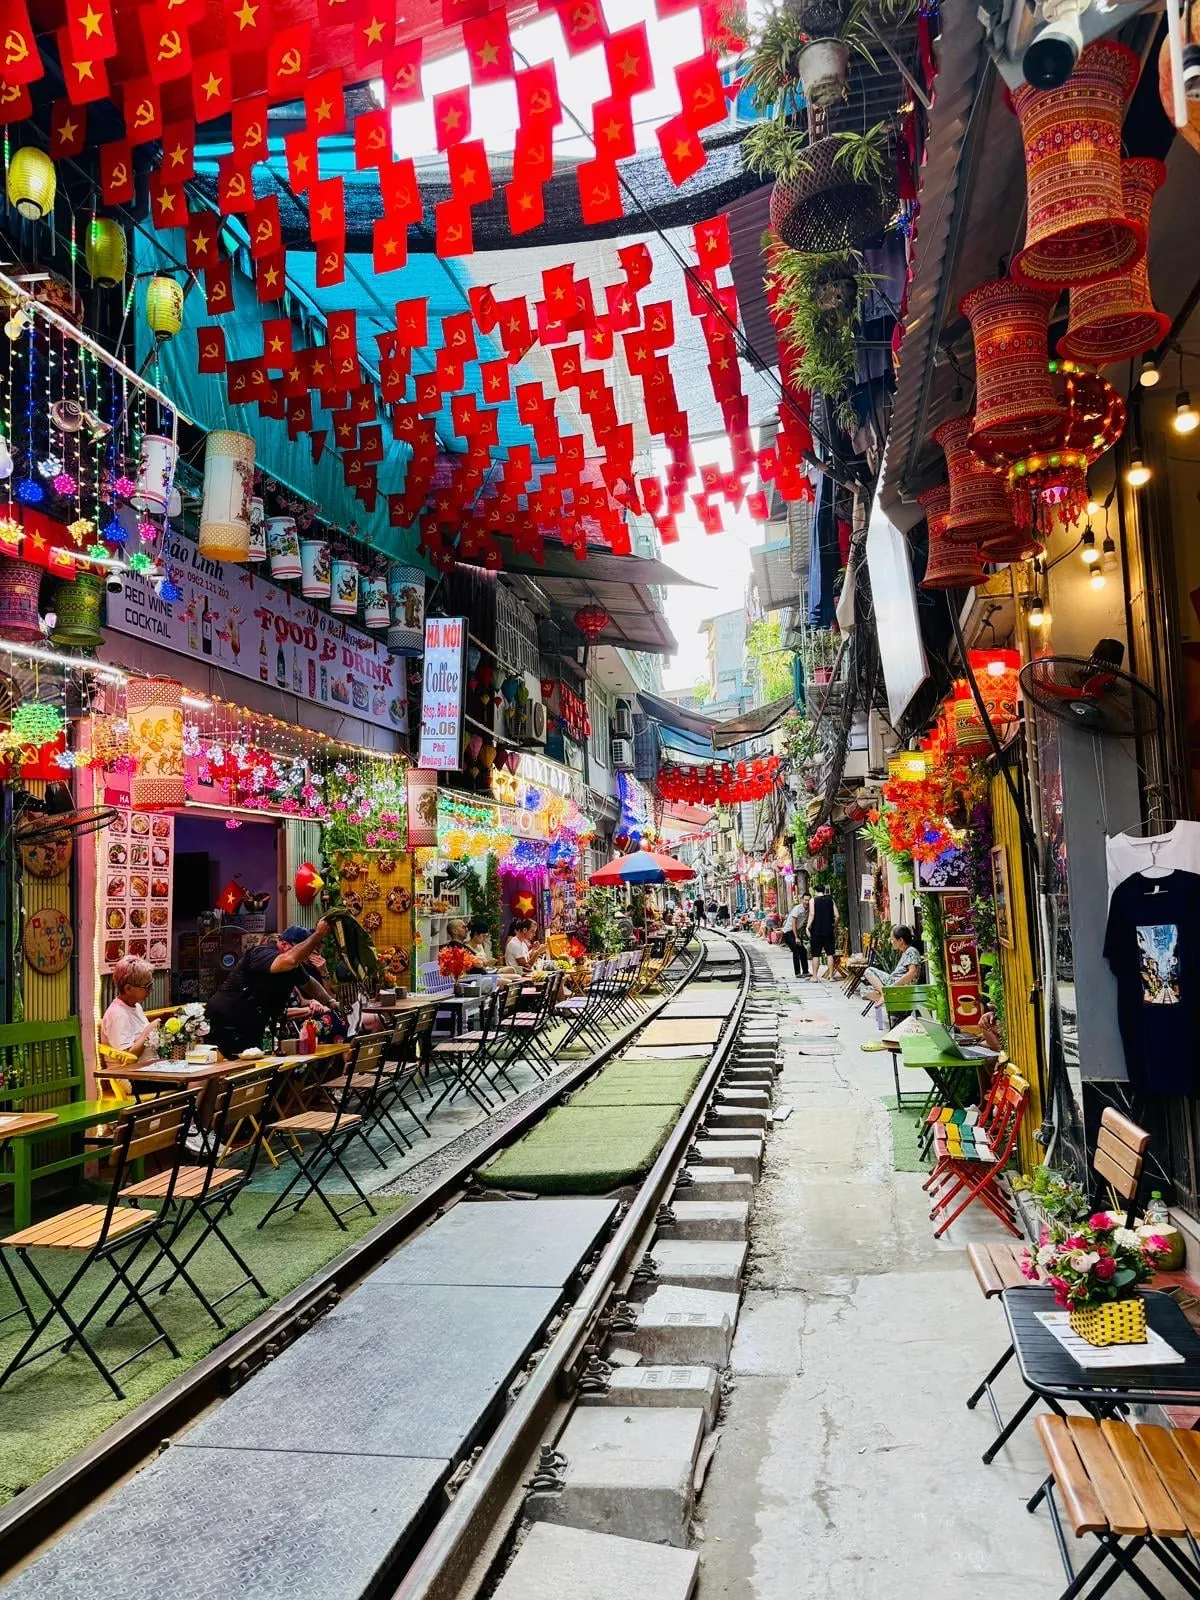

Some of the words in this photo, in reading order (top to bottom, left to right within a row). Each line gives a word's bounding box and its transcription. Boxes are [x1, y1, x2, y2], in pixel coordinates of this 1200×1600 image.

[191, 547, 224, 581] Linh
[187, 571, 204, 588] 0902
[205, 580, 217, 594] 121
[124, 585, 145, 607] RED
[148, 594, 173, 618] WINE
[125, 607, 172, 639] COCKTAIL
[320, 616, 326, 631] 6
[443, 618, 461, 654] NỘI
[257, 606, 318, 652] FOOD
[341, 646, 394, 688] DRINK
[425, 661, 459, 693] Coffee
